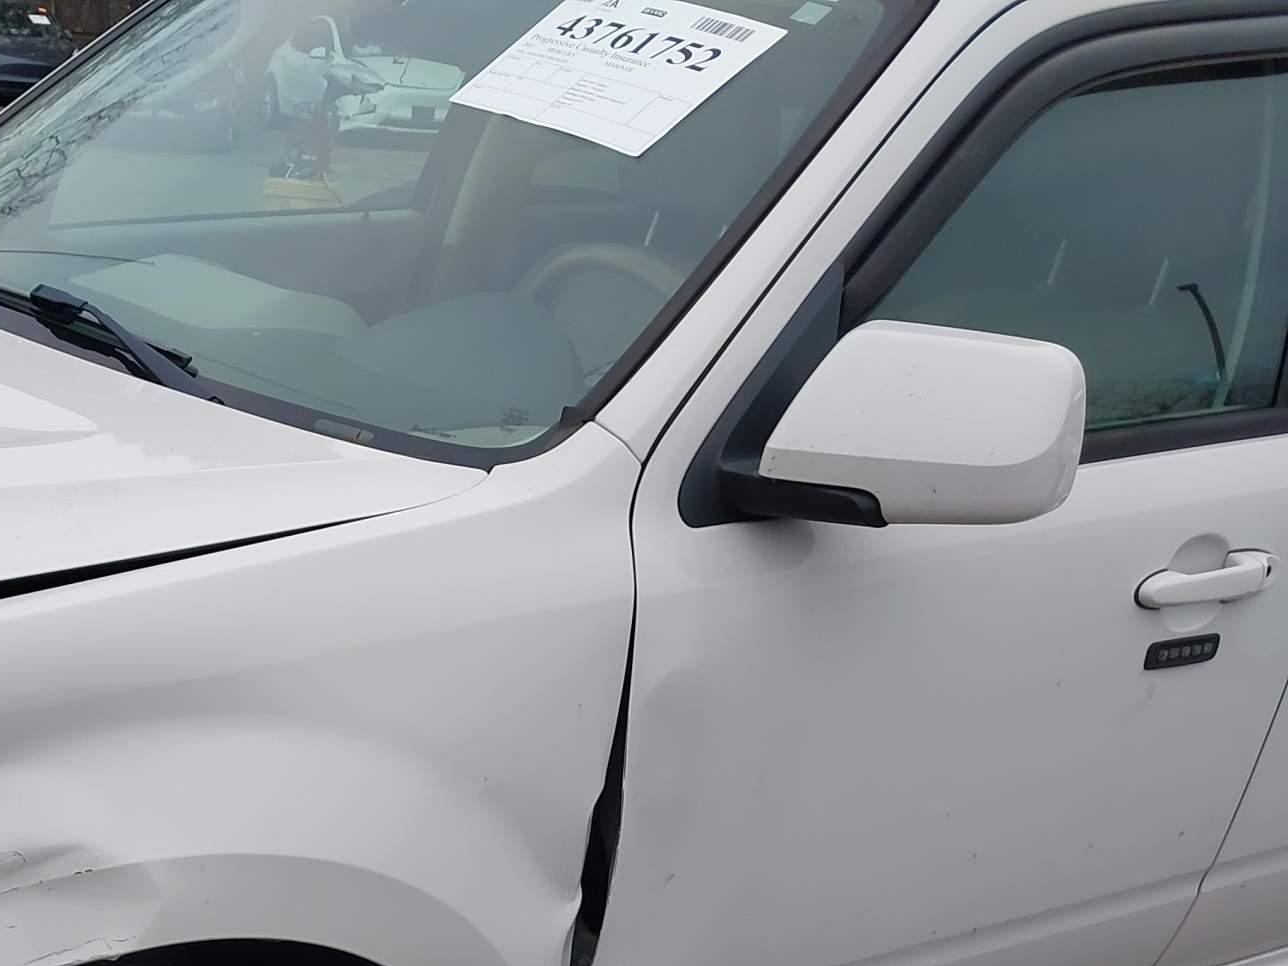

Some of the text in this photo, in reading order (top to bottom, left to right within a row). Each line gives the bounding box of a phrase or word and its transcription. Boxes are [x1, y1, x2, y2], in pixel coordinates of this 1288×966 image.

[531, 33, 576, 48] Progressive
[575, 43, 609, 57] Casualty
[610, 52, 651, 68] Insurance
[556, 15, 722, 72] 43761752
